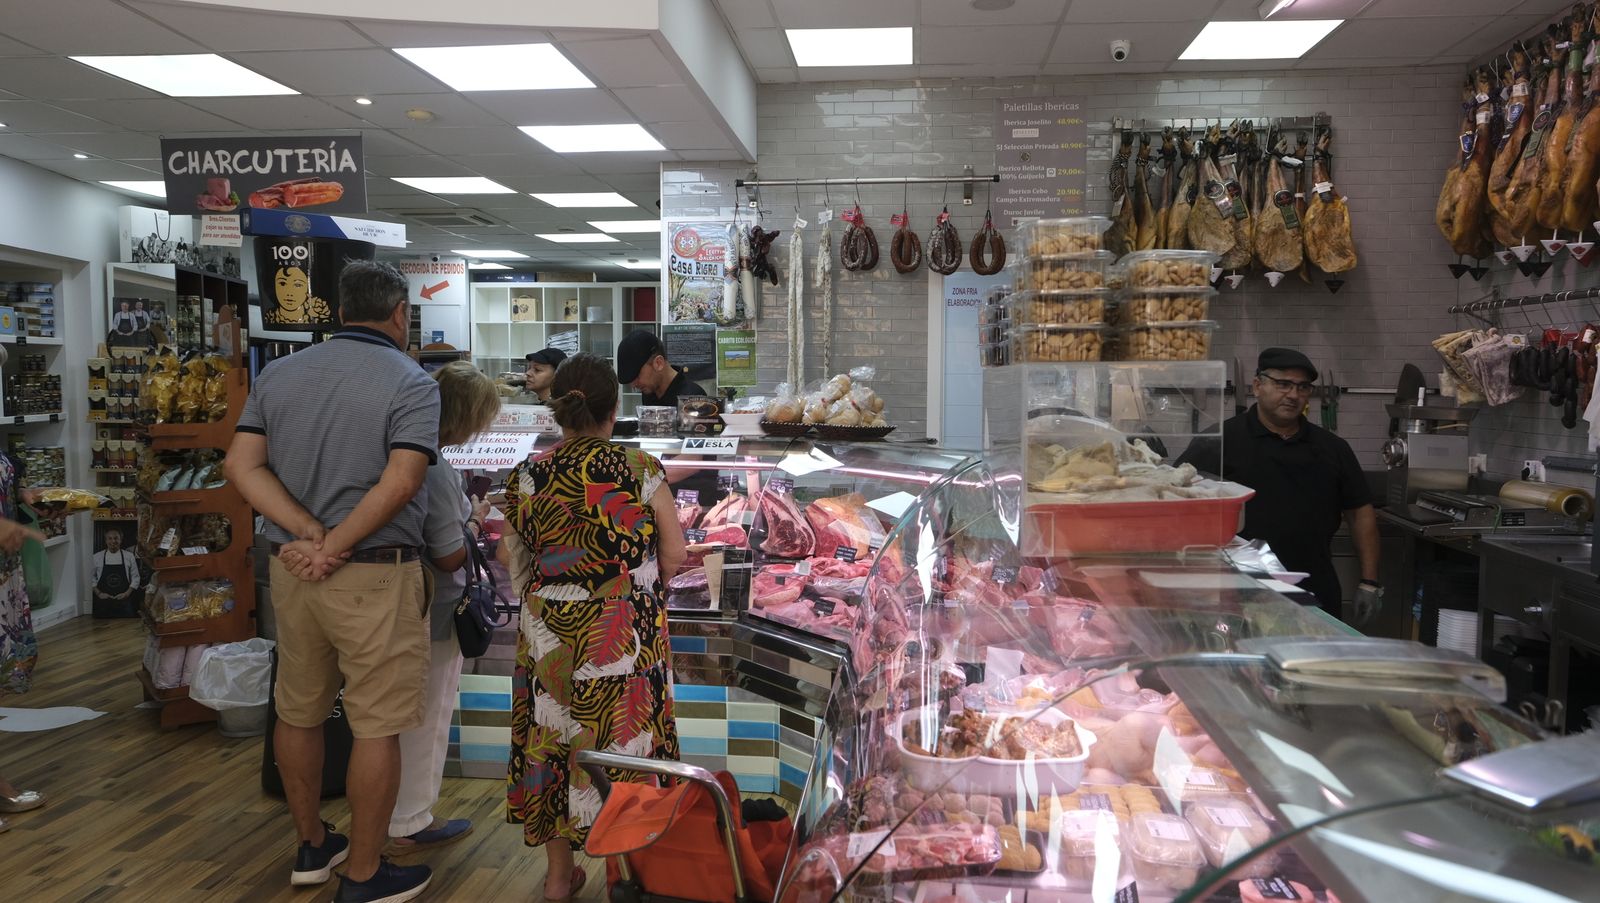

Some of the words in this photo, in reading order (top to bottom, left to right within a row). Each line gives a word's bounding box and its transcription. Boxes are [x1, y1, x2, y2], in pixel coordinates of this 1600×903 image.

[1003, 102, 1042, 112] Paletillas
[1045, 102, 1080, 111] Ibericas
[168, 141, 357, 174] CHARCUTERÍA
[271, 245, 309, 260] 100
[401, 263, 430, 274] RECOGIDA
[431, 263, 439, 274] DE
[440, 263, 465, 275] PEDIDOS
[952, 287, 966, 295] ZONA
[476, 446, 516, 454] 14:00h
